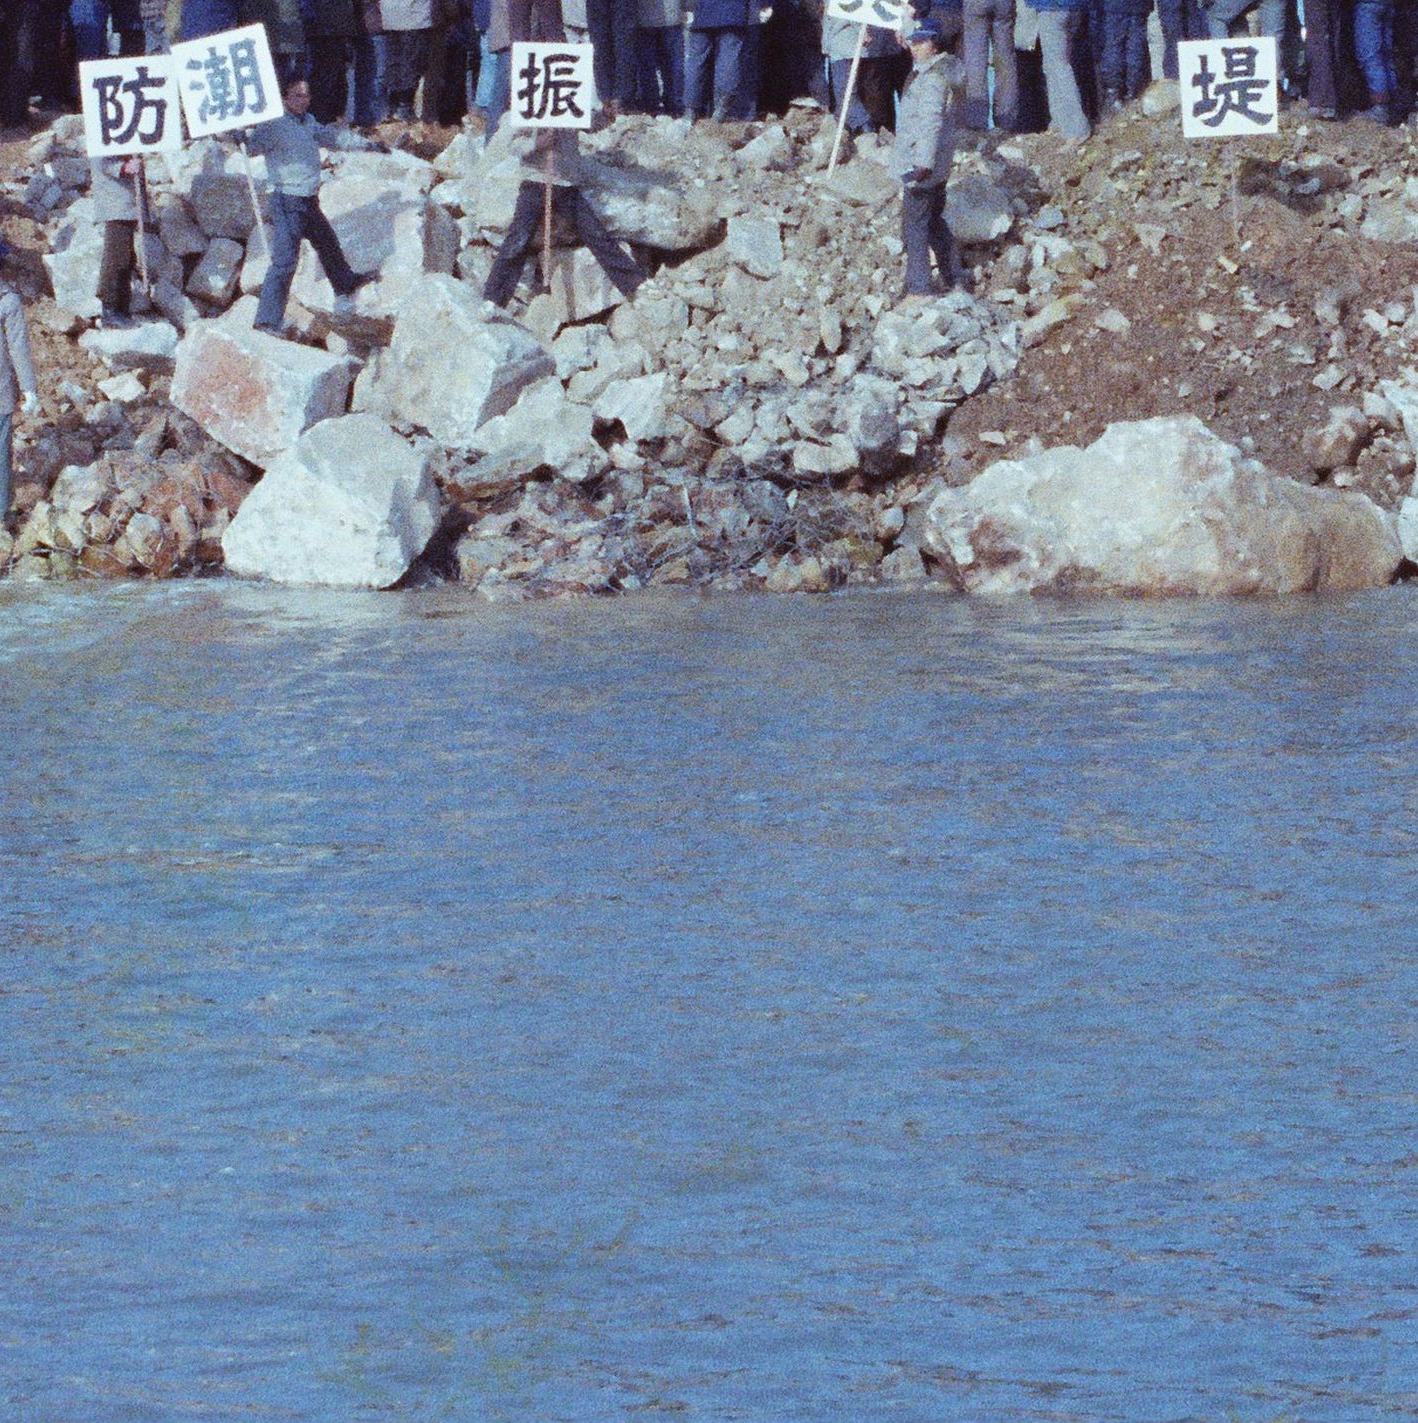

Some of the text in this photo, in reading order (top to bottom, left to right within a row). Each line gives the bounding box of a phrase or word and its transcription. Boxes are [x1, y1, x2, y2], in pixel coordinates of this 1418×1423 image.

[92, 66, 168, 146] 防
[185, 37, 267, 124] 潮
[517, 52, 584, 119] 振
[1191, 45, 1273, 127] 堤
